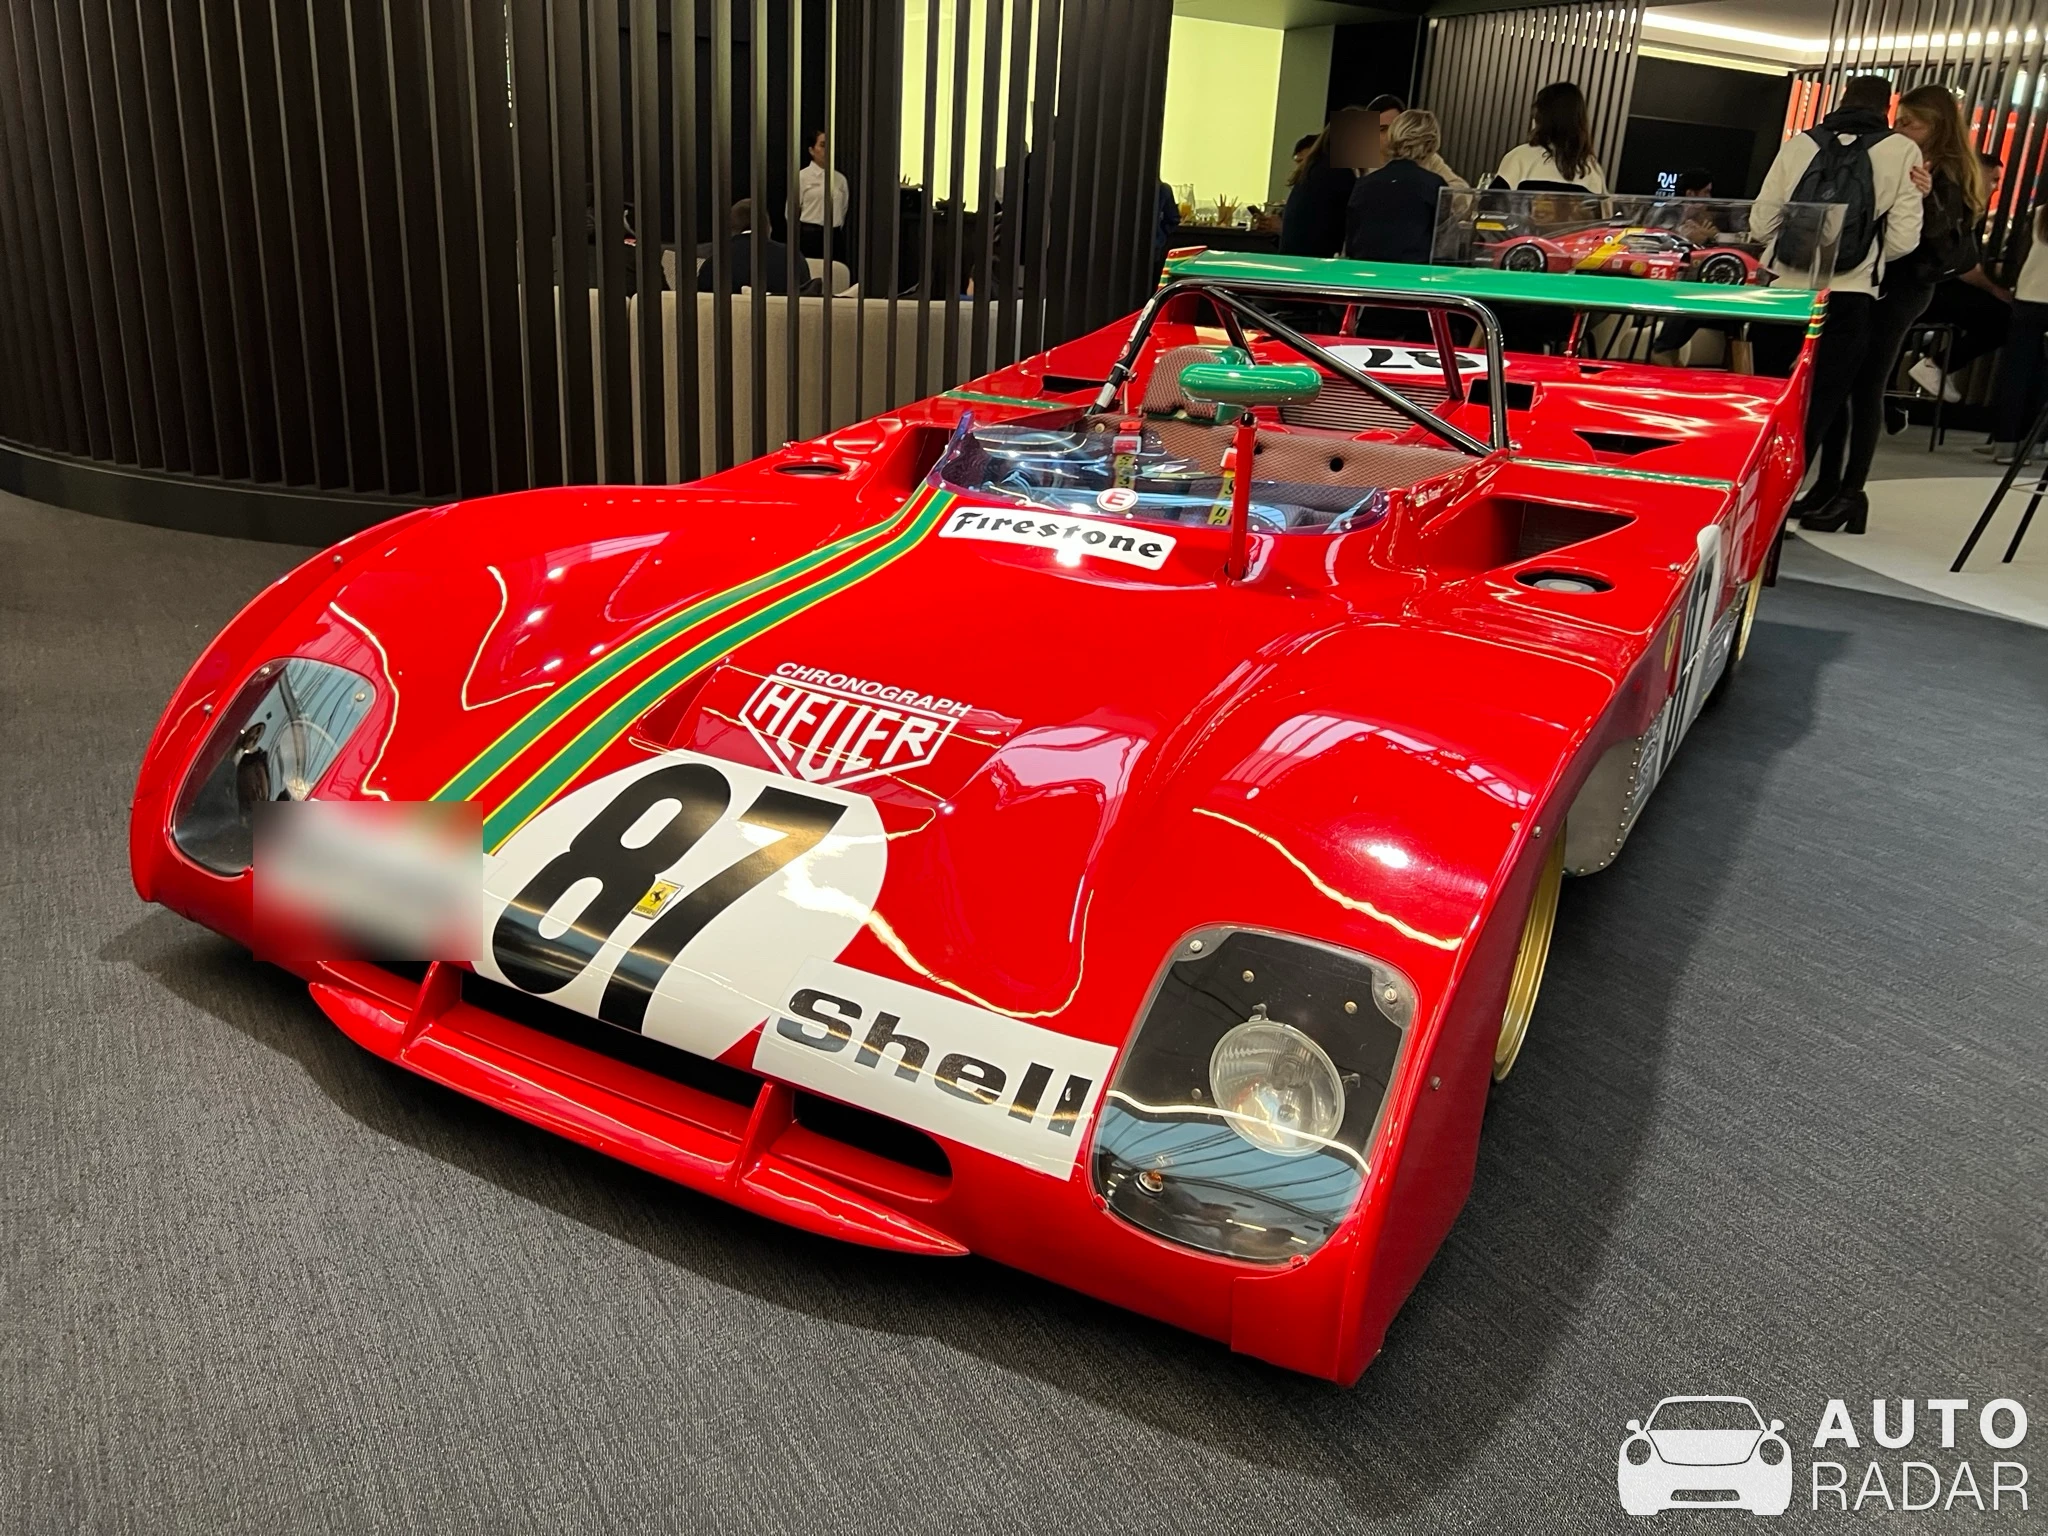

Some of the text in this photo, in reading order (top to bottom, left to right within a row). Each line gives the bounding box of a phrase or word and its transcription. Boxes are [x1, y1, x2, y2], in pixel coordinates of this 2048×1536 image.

[1650, 266, 1668, 280] 51
[1364, 347, 1481, 369] 87
[1105, 491, 1131, 506] E
[952, 512, 1163, 558] Firestone
[776, 661, 973, 718] CHRONOGRAPH
[752, 684, 940, 783] HEUER
[492, 762, 849, 1036] 87
[776, 987, 1093, 1137] Shell
